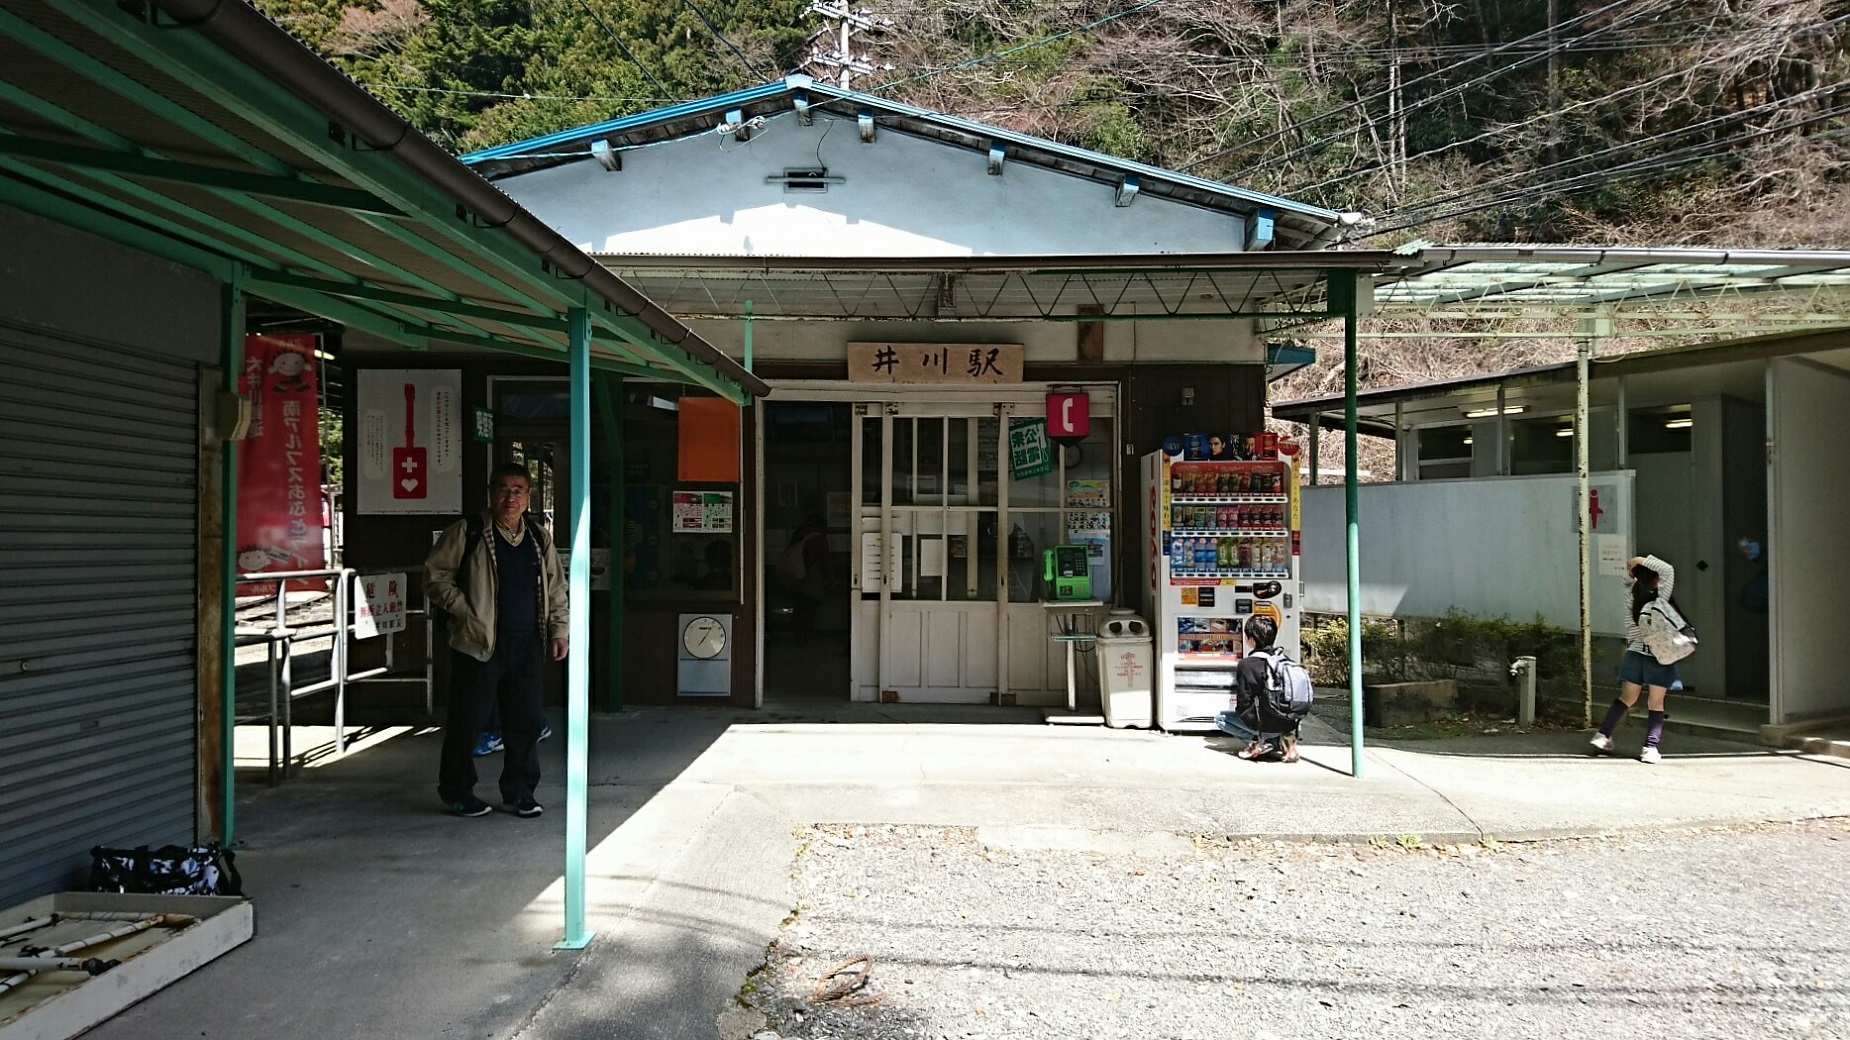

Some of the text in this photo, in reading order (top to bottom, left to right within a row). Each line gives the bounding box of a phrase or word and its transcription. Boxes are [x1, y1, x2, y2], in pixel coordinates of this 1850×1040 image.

[871, 345, 1003, 377] 井川駅
[366, 580, 399, 599] 危険
